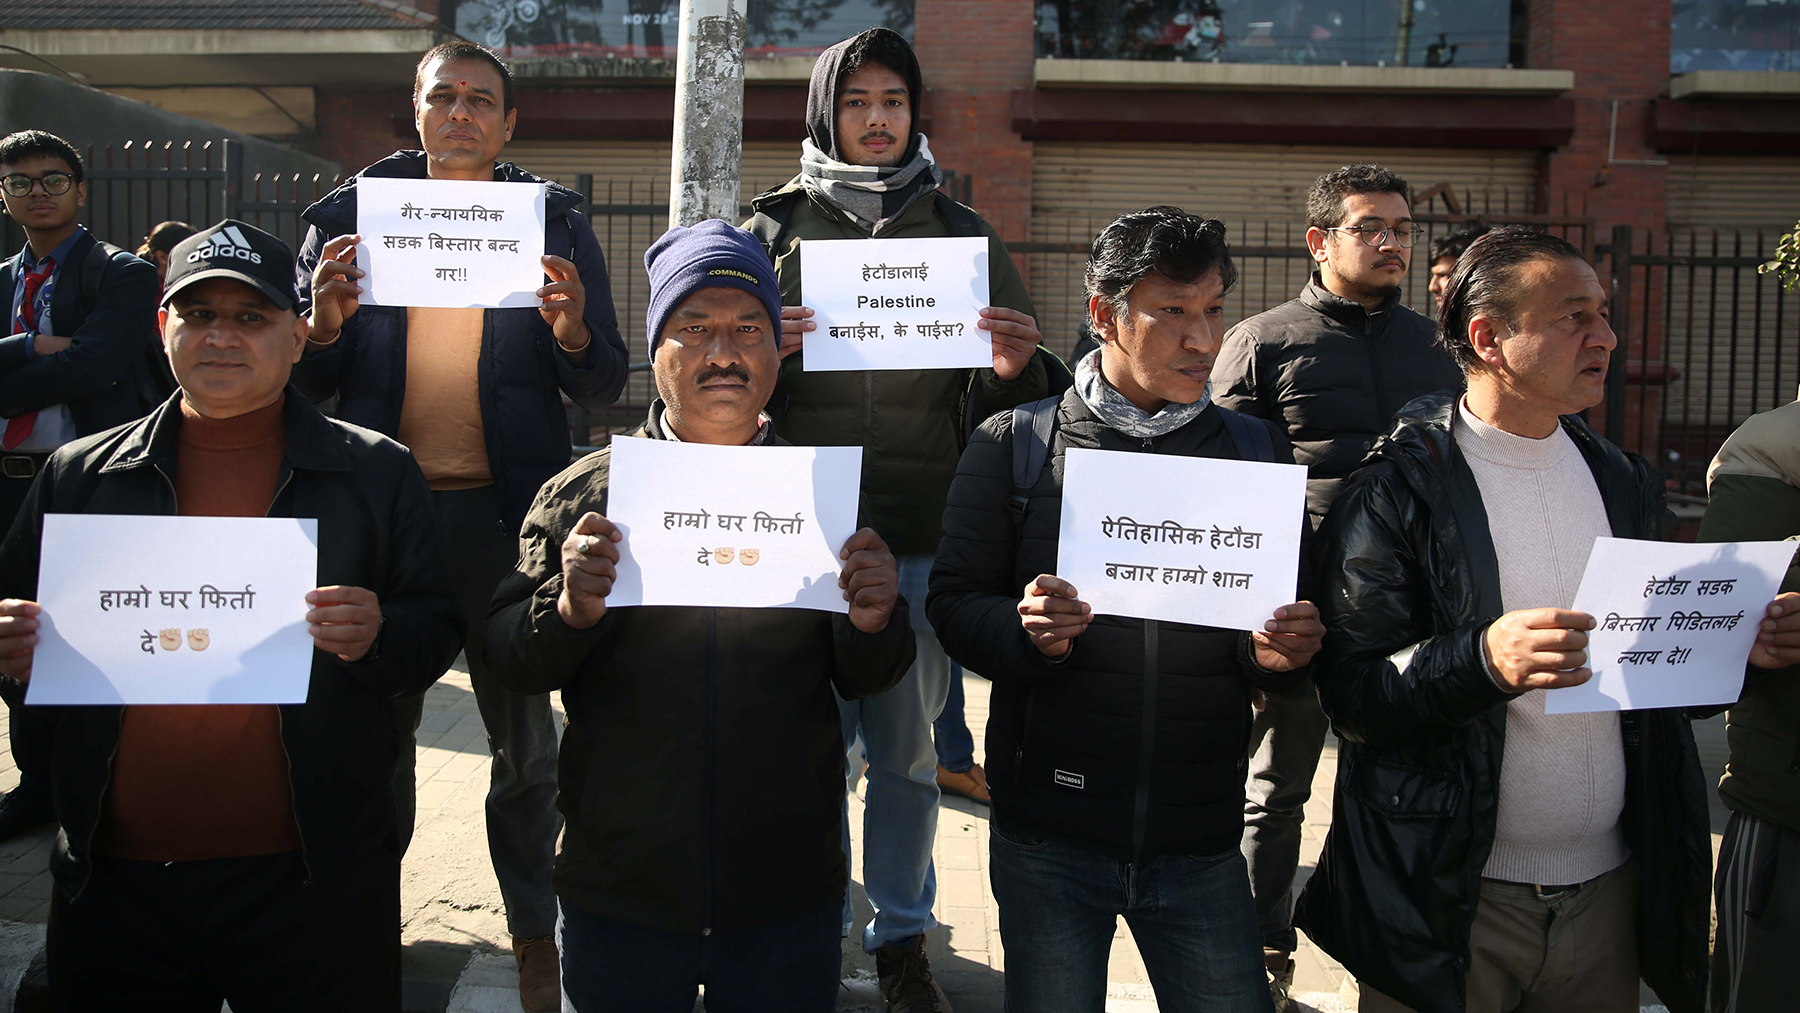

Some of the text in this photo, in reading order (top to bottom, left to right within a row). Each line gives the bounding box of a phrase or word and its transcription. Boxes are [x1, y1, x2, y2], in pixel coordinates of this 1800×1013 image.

[401, 202, 504, 222] गैर-न्याययिक
[383, 233, 520, 253] सडक बिस्तार बन्द
[187, 245, 262, 264] adidas
[435, 268, 466, 281] गर!!
[709, 270, 758, 284] COMMANDO
[862, 262, 929, 282] हेटौडालाई
[858, 295, 935, 308] Palestine
[829, 320, 964, 341] बनाईस, के पाईस?
[664, 508, 804, 534] हाम्रो घर फिर्ता
[1101, 515, 1262, 550] ऐतिहासिक हेटौडा
[697, 547, 713, 566] दे
[1105, 563, 1253, 589] बजार हाम्रो शान
[1643, 576, 1737, 598] हेटौडा सडक
[100, 584, 256, 611] हाम्रो घर फिर्ता
[1600, 610, 1744, 632] बिस्तार पिडितलाई
[141, 629, 158, 654] दे
[1617, 646, 1692, 665] न्याय दे!!
